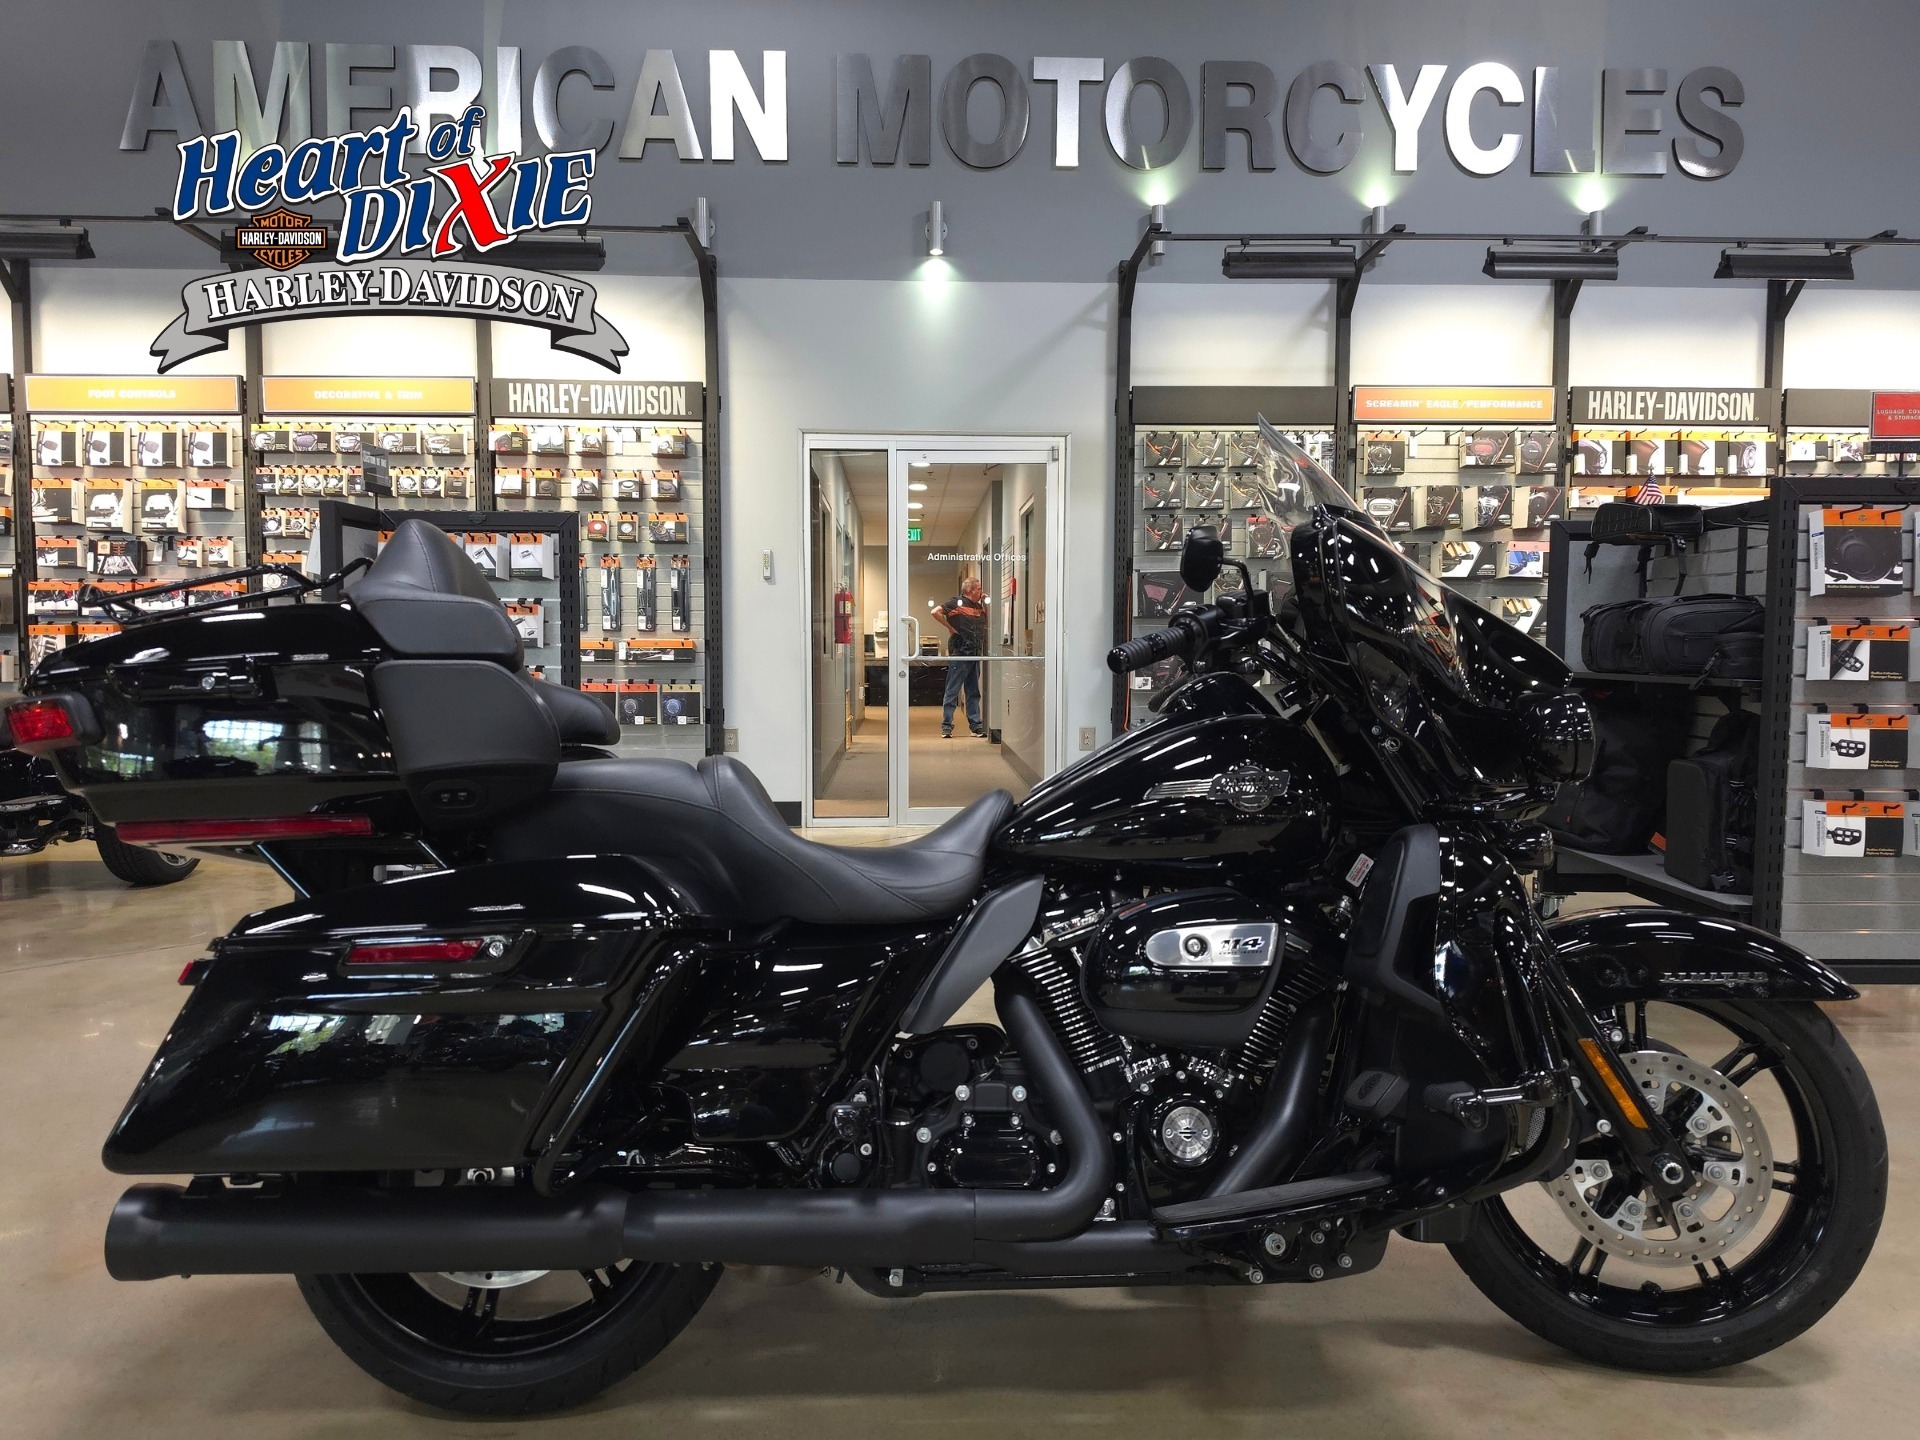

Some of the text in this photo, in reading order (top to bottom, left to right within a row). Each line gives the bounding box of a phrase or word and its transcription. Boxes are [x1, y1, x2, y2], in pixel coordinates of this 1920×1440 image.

[118, 39, 1746, 180] AMERICAN MOTORCYCLES
[87, 388, 176, 399] FOOT CONTROLS
[313, 390, 423, 400] DECORATIVE & TRIM
[508, 382, 687, 416] HARLEY-DAVIDSON
[1365, 399, 1423, 409] SCREAMIN'
[1588, 390, 1755, 421] HARLEY-DAVIDSON
[927, 552, 1027, 561] Administrative Offices
[1220, 936, 1265, 950] 114
[1660, 971, 1769, 984] LIMITED
